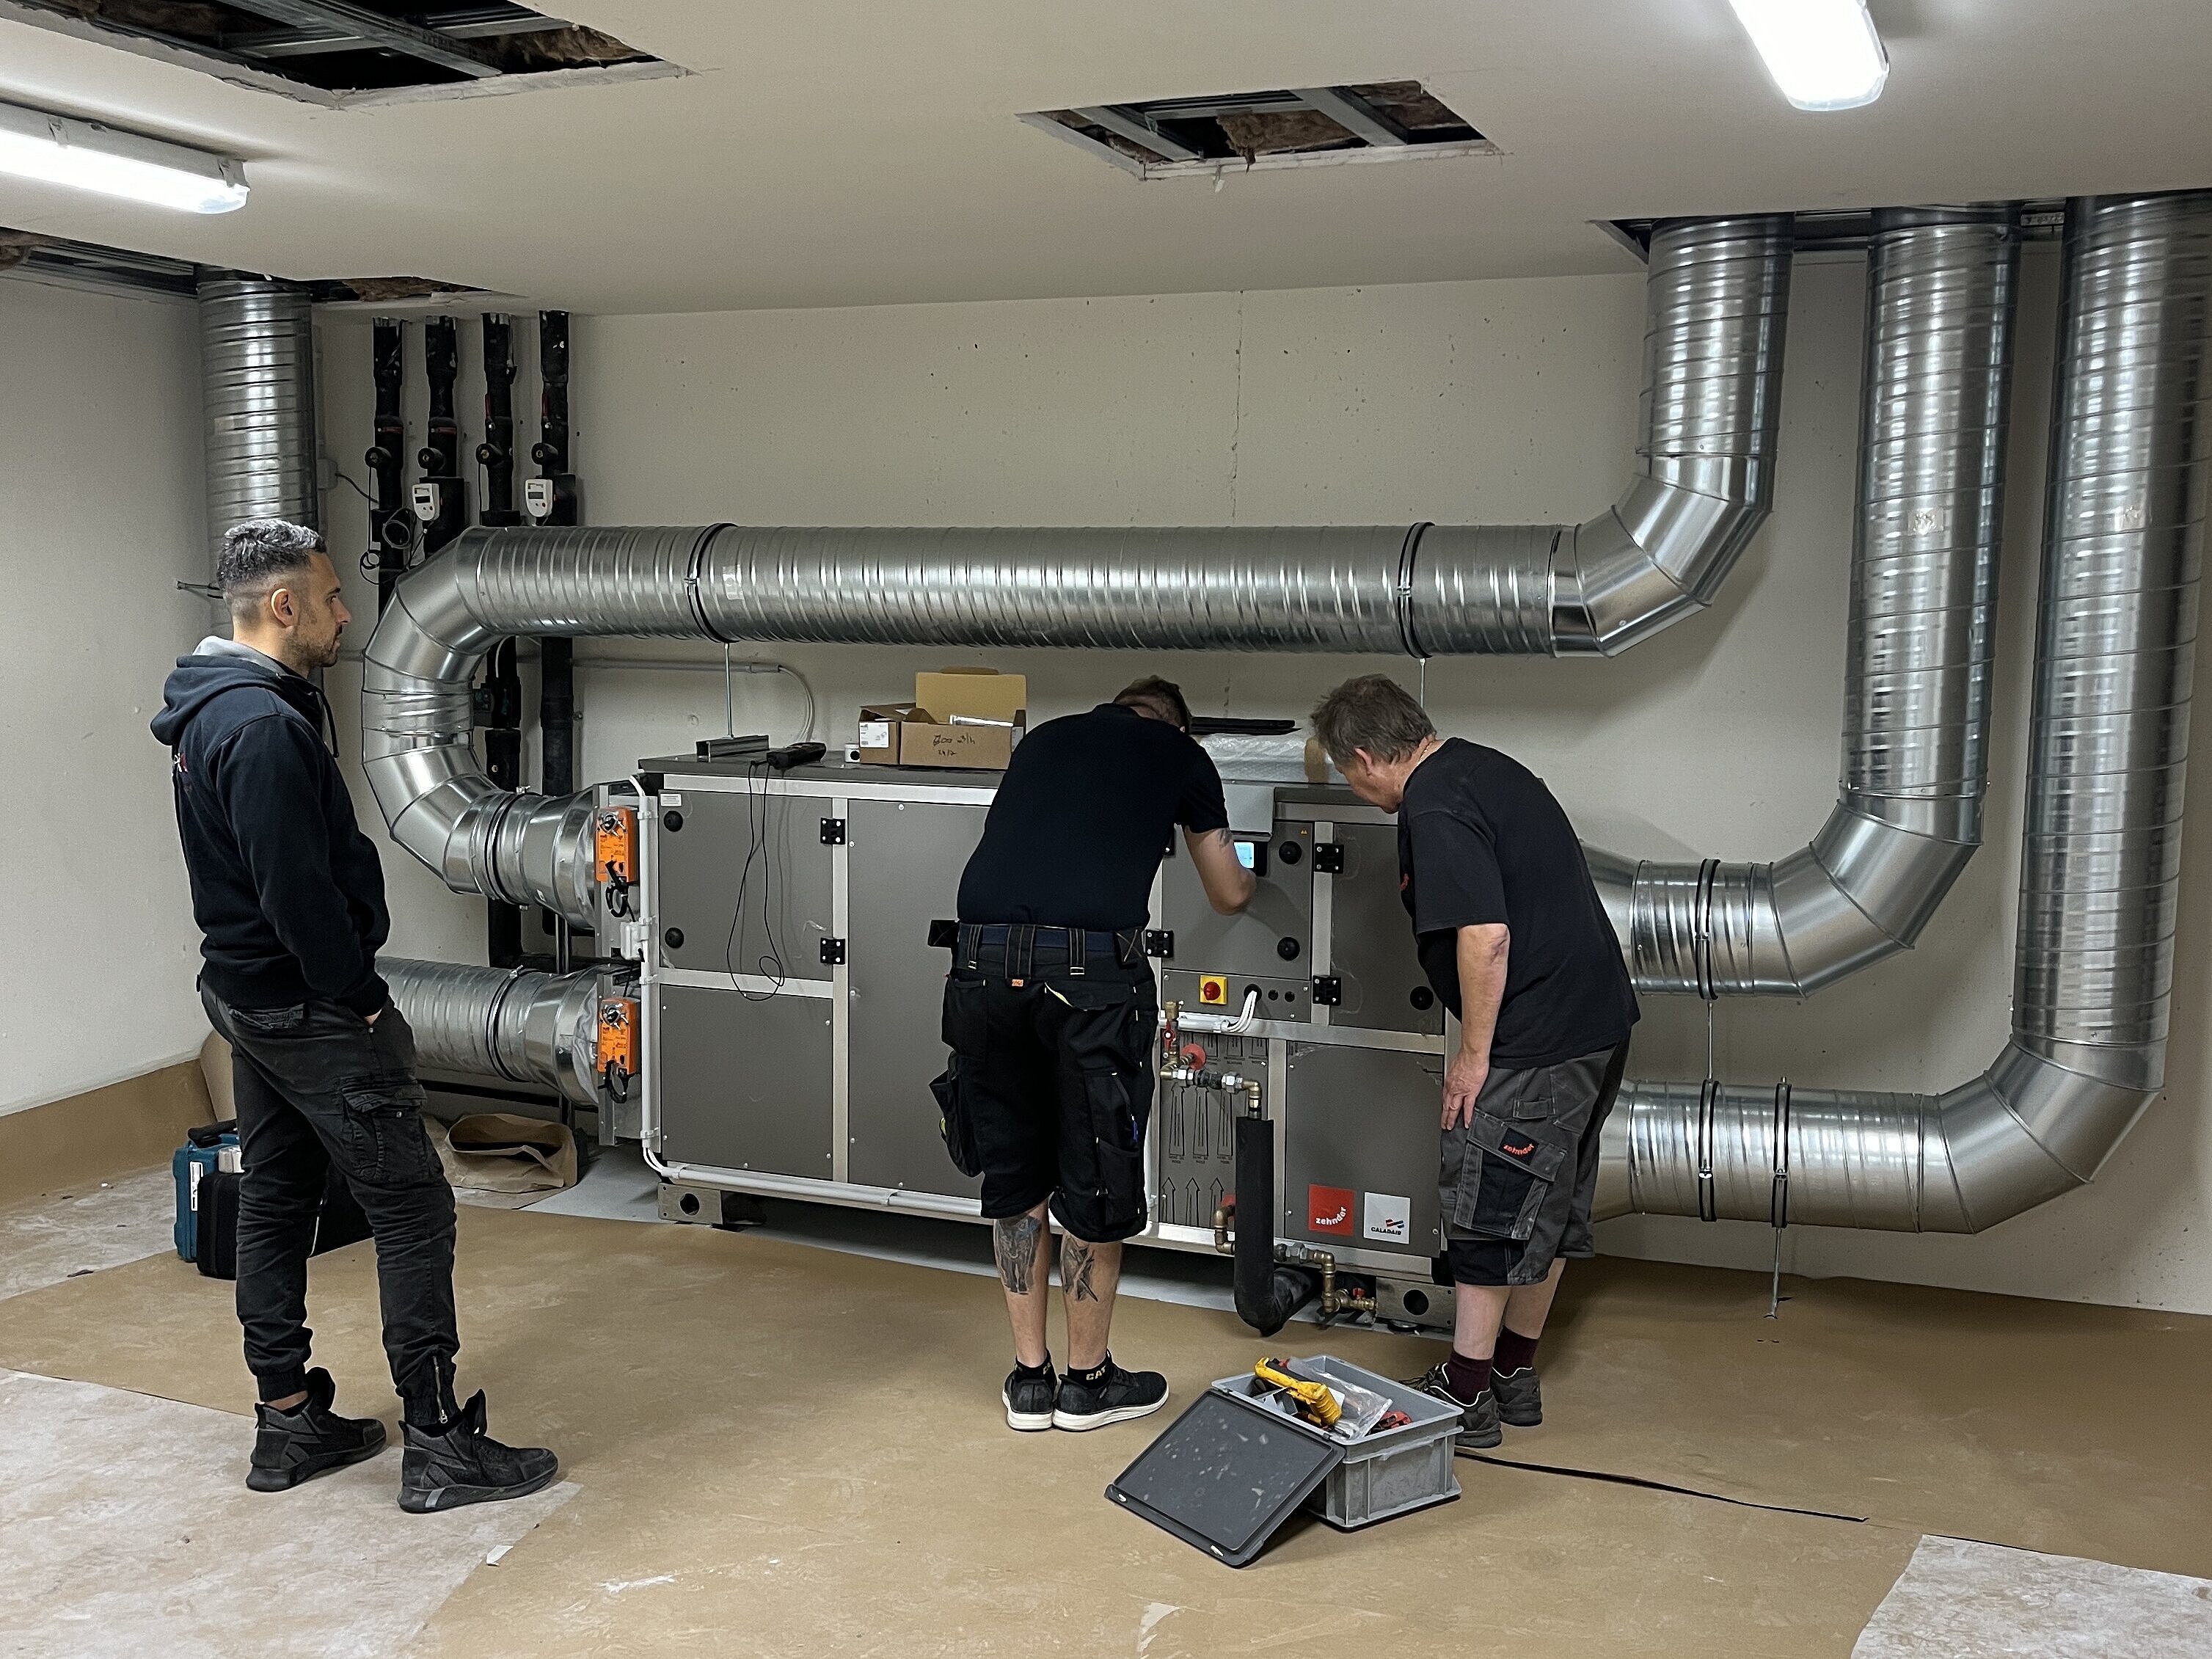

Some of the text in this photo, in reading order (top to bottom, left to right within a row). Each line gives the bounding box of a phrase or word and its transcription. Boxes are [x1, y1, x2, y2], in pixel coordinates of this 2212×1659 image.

[1315, 1206, 1347, 1225] zehnder
[1370, 1227, 1402, 1236] CALADAIR
[1086, 1365, 1106, 1381] CAT
